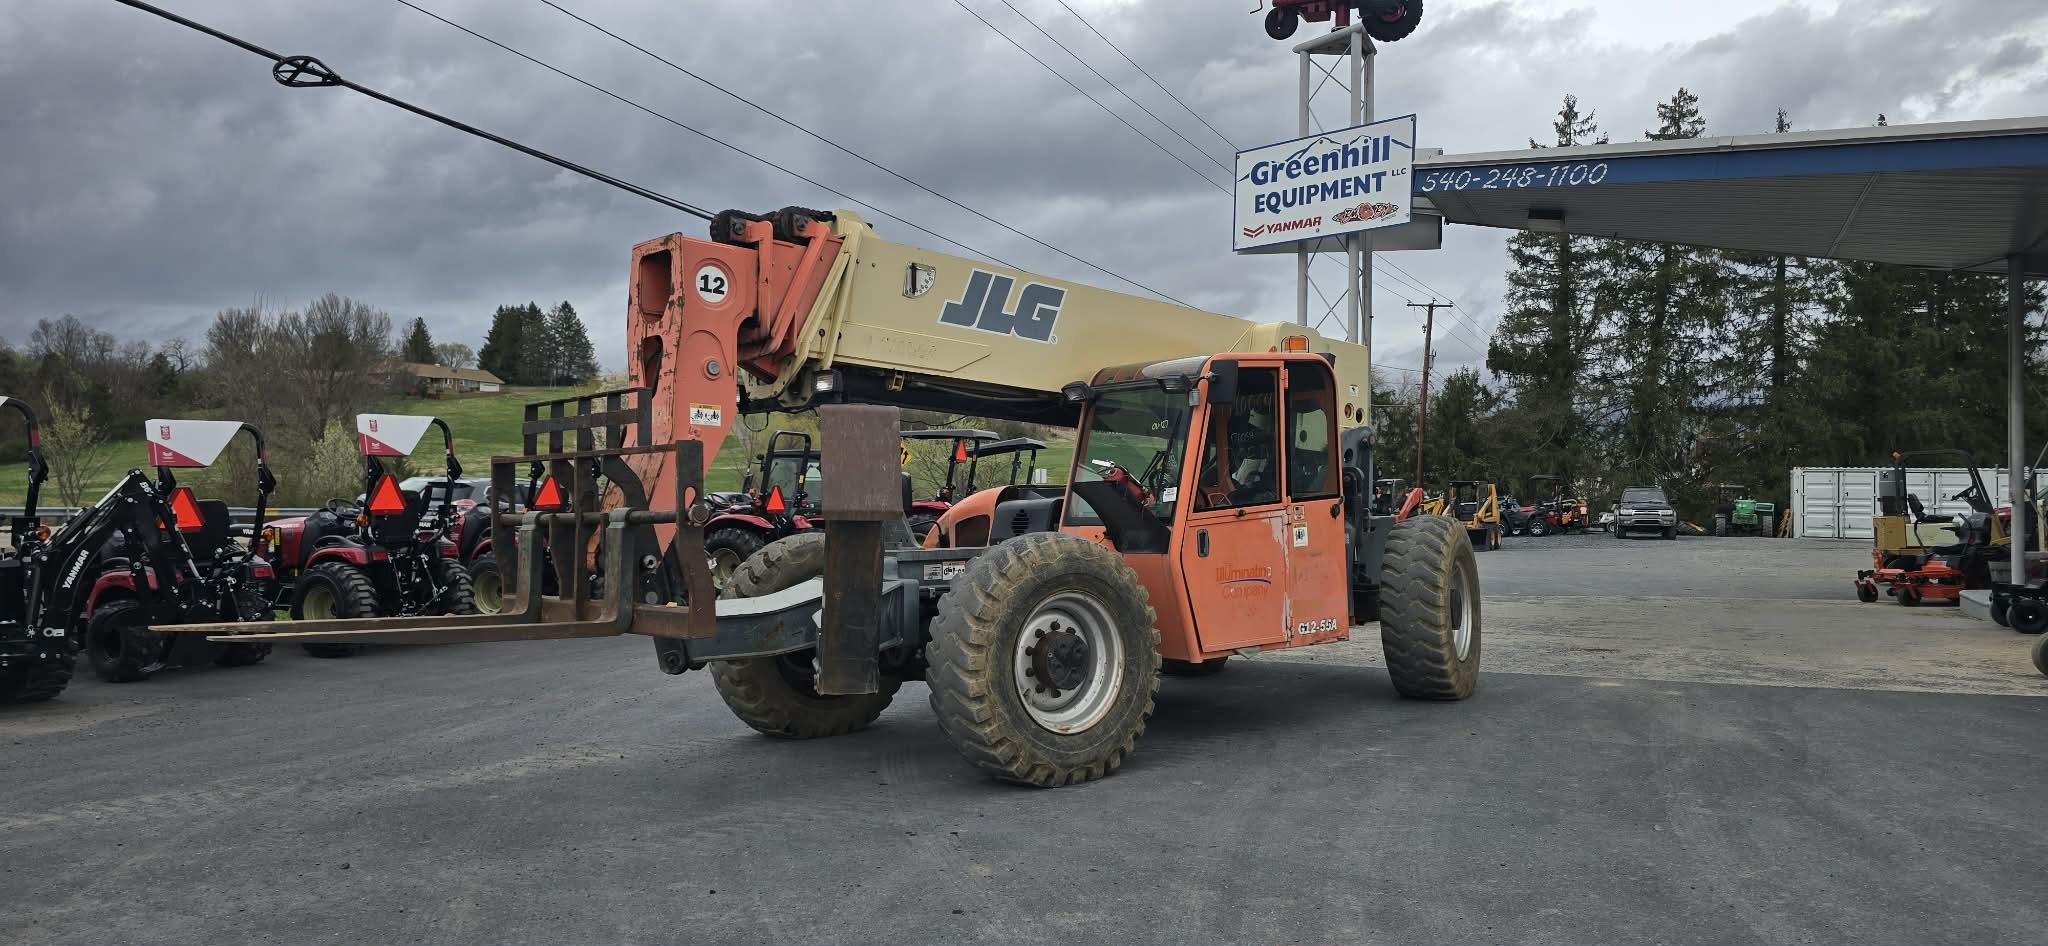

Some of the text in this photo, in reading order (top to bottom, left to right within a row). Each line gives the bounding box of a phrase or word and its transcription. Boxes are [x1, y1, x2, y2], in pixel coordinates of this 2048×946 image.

[1251, 135, 1391, 186] Greenhill
[1421, 162, 1608, 192] 540-248-1100
[1255, 167, 1407, 214] EQUIPMENT LLC
[1266, 216, 1322, 234] YANMAR
[699, 274, 725, 295] 12
[938, 269, 1067, 343] JLG
[62, 549, 89, 589] YANMAR
